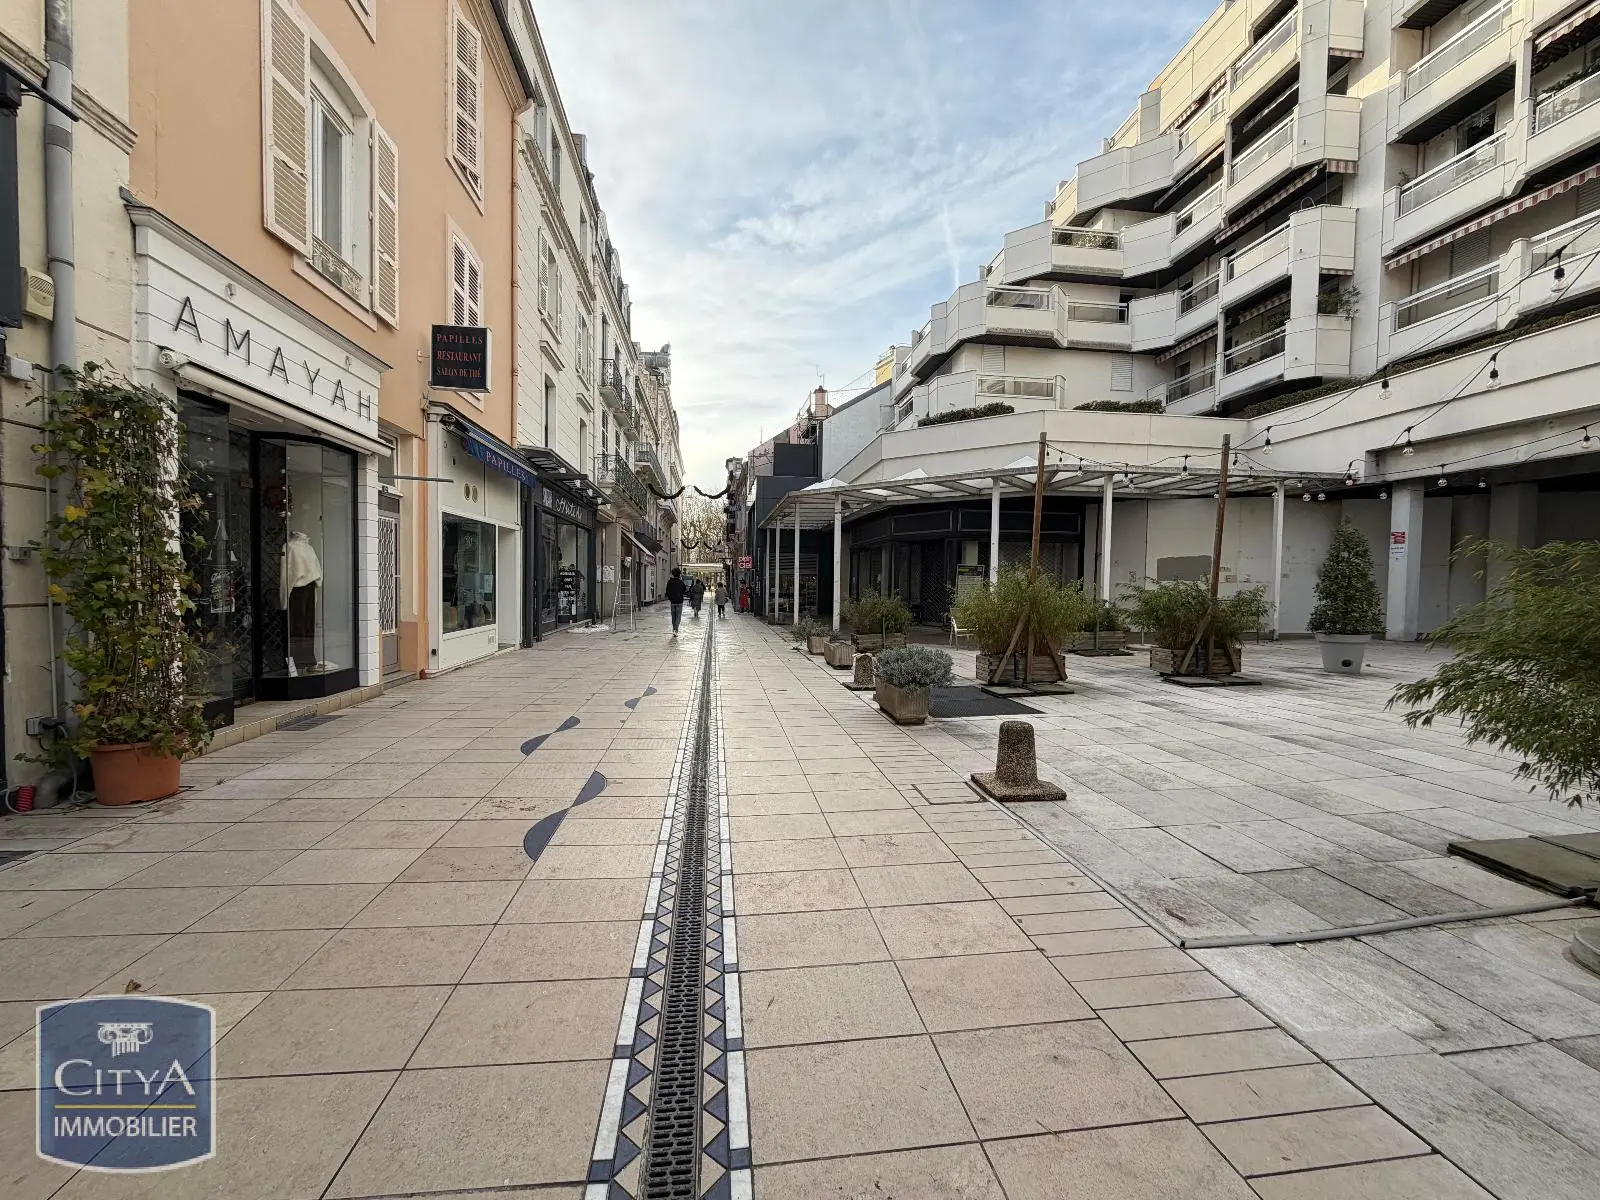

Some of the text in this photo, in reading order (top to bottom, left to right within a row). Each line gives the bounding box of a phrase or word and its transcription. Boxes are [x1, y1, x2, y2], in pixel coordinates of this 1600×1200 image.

[436, 333, 484, 345] PAPILLES
[174, 295, 372, 423] AMAYAH
[437, 350, 482, 362] RESTAURANT
[436, 366, 458, 377] SALON
[459, 368, 468, 377] DE
[486, 450, 527, 481] PAPILLES
